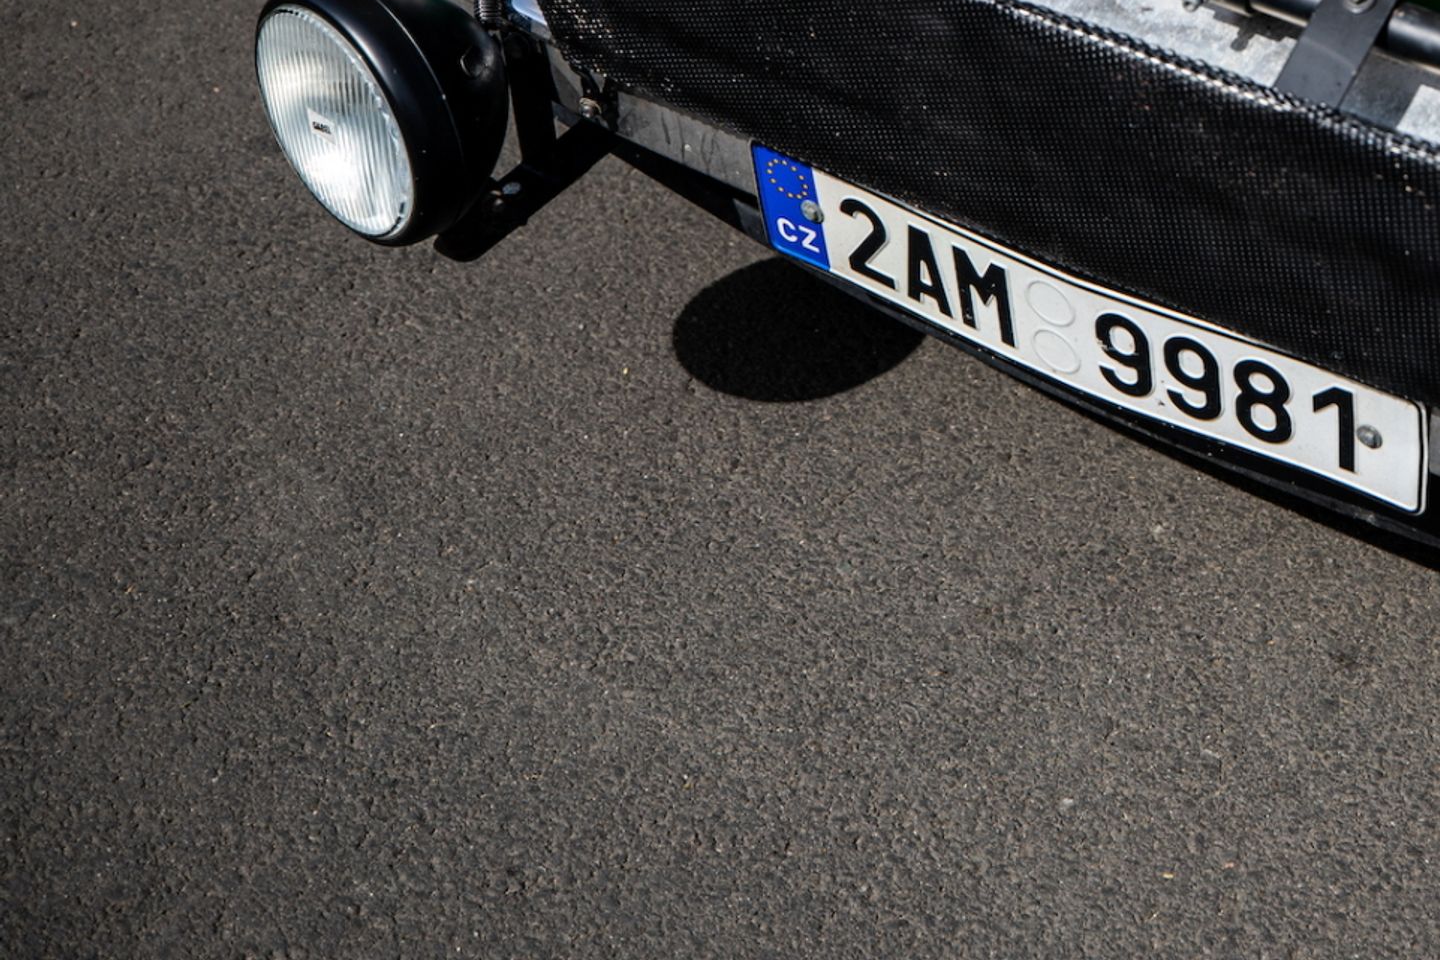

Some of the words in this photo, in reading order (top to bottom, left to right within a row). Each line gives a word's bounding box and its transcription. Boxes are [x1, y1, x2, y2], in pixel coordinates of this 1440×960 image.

[776, 217, 821, 254] CZ
[839, 197, 1016, 348] 2AM
[1094, 311, 1358, 473] 9981
